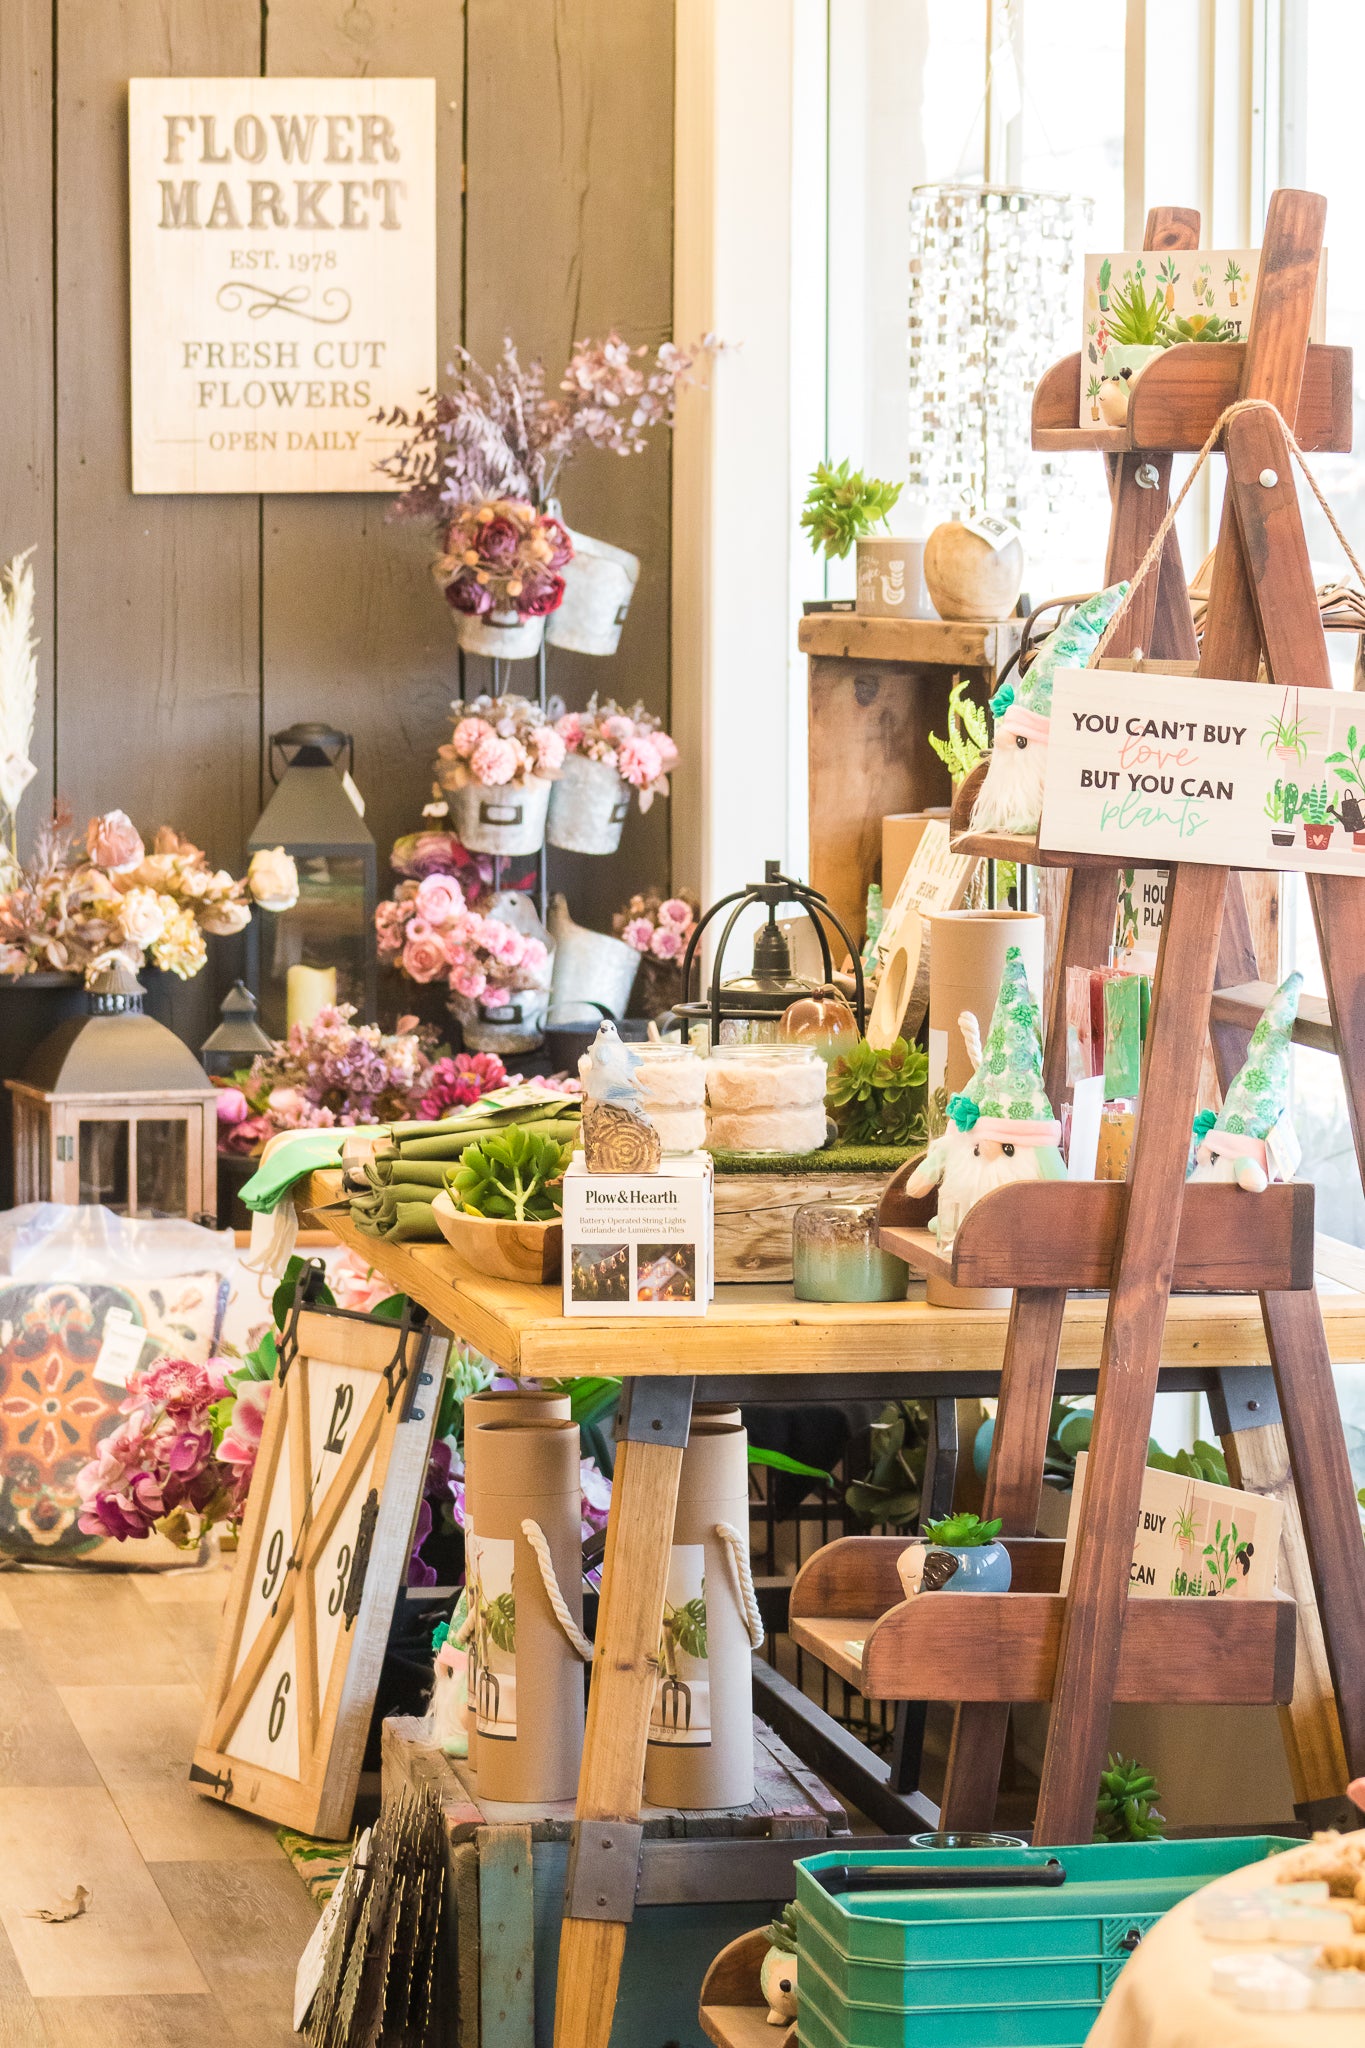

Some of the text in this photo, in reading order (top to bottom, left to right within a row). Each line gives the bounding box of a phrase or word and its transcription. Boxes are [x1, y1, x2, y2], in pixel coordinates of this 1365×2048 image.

[162, 113, 401, 165] FLOWER
[157, 178, 408, 231] MARKET
[229, 249, 337, 273] EST. 1978
[182, 341, 387, 369] FRESH CUT
[197, 380, 372, 409] FLOWERS
[208, 431, 362, 451] OPEN DAILY
[1072, 712, 1247, 746] YOU CAN'T BUY
[1118, 725, 1199, 769] love
[1080, 769, 1234, 800] BUT YOU CAN
[1100, 788, 1209, 838] plants
[579, 1216, 686, 1225] Battery Operated String Lights
[581, 1226, 616, 1234] Guirlande
[617, 1226, 627, 1234] de
[668, 1226, 685, 1234] Piles
[323, 1383, 353, 1455] 12
[1144, 1511, 1166, 1533] BUY
[262, 1529, 284, 1600] 9
[328, 1544, 351, 1617] 3
[1129, 1562, 1155, 1585] CAN
[268, 1671, 291, 1743] 6
